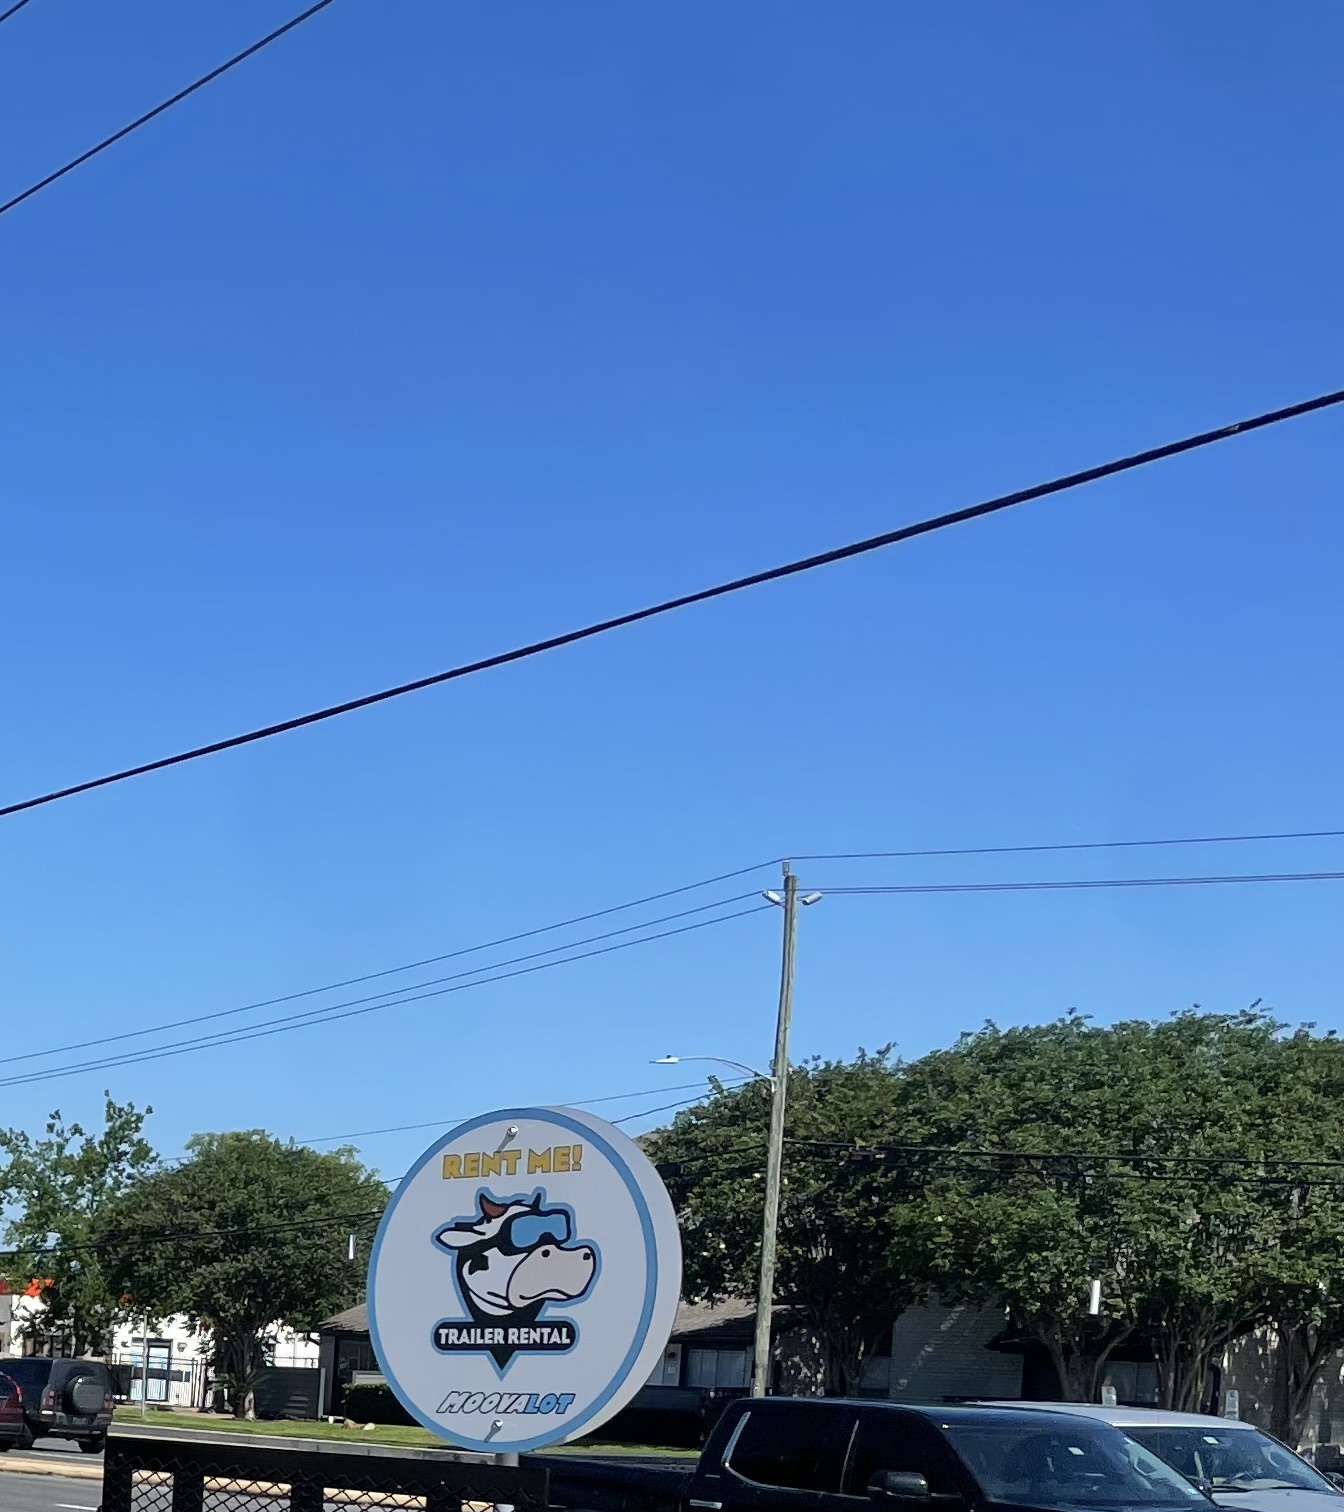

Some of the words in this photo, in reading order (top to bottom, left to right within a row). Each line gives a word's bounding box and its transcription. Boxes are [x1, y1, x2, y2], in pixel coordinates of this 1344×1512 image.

[442, 1150, 521, 1179] RENT
[527, 1144, 583, 1174] ME!
[438, 1328, 504, 1345] TRAILER
[507, 1327, 570, 1344] RENTAL
[436, 1391, 575, 1414] MOOVALOT
